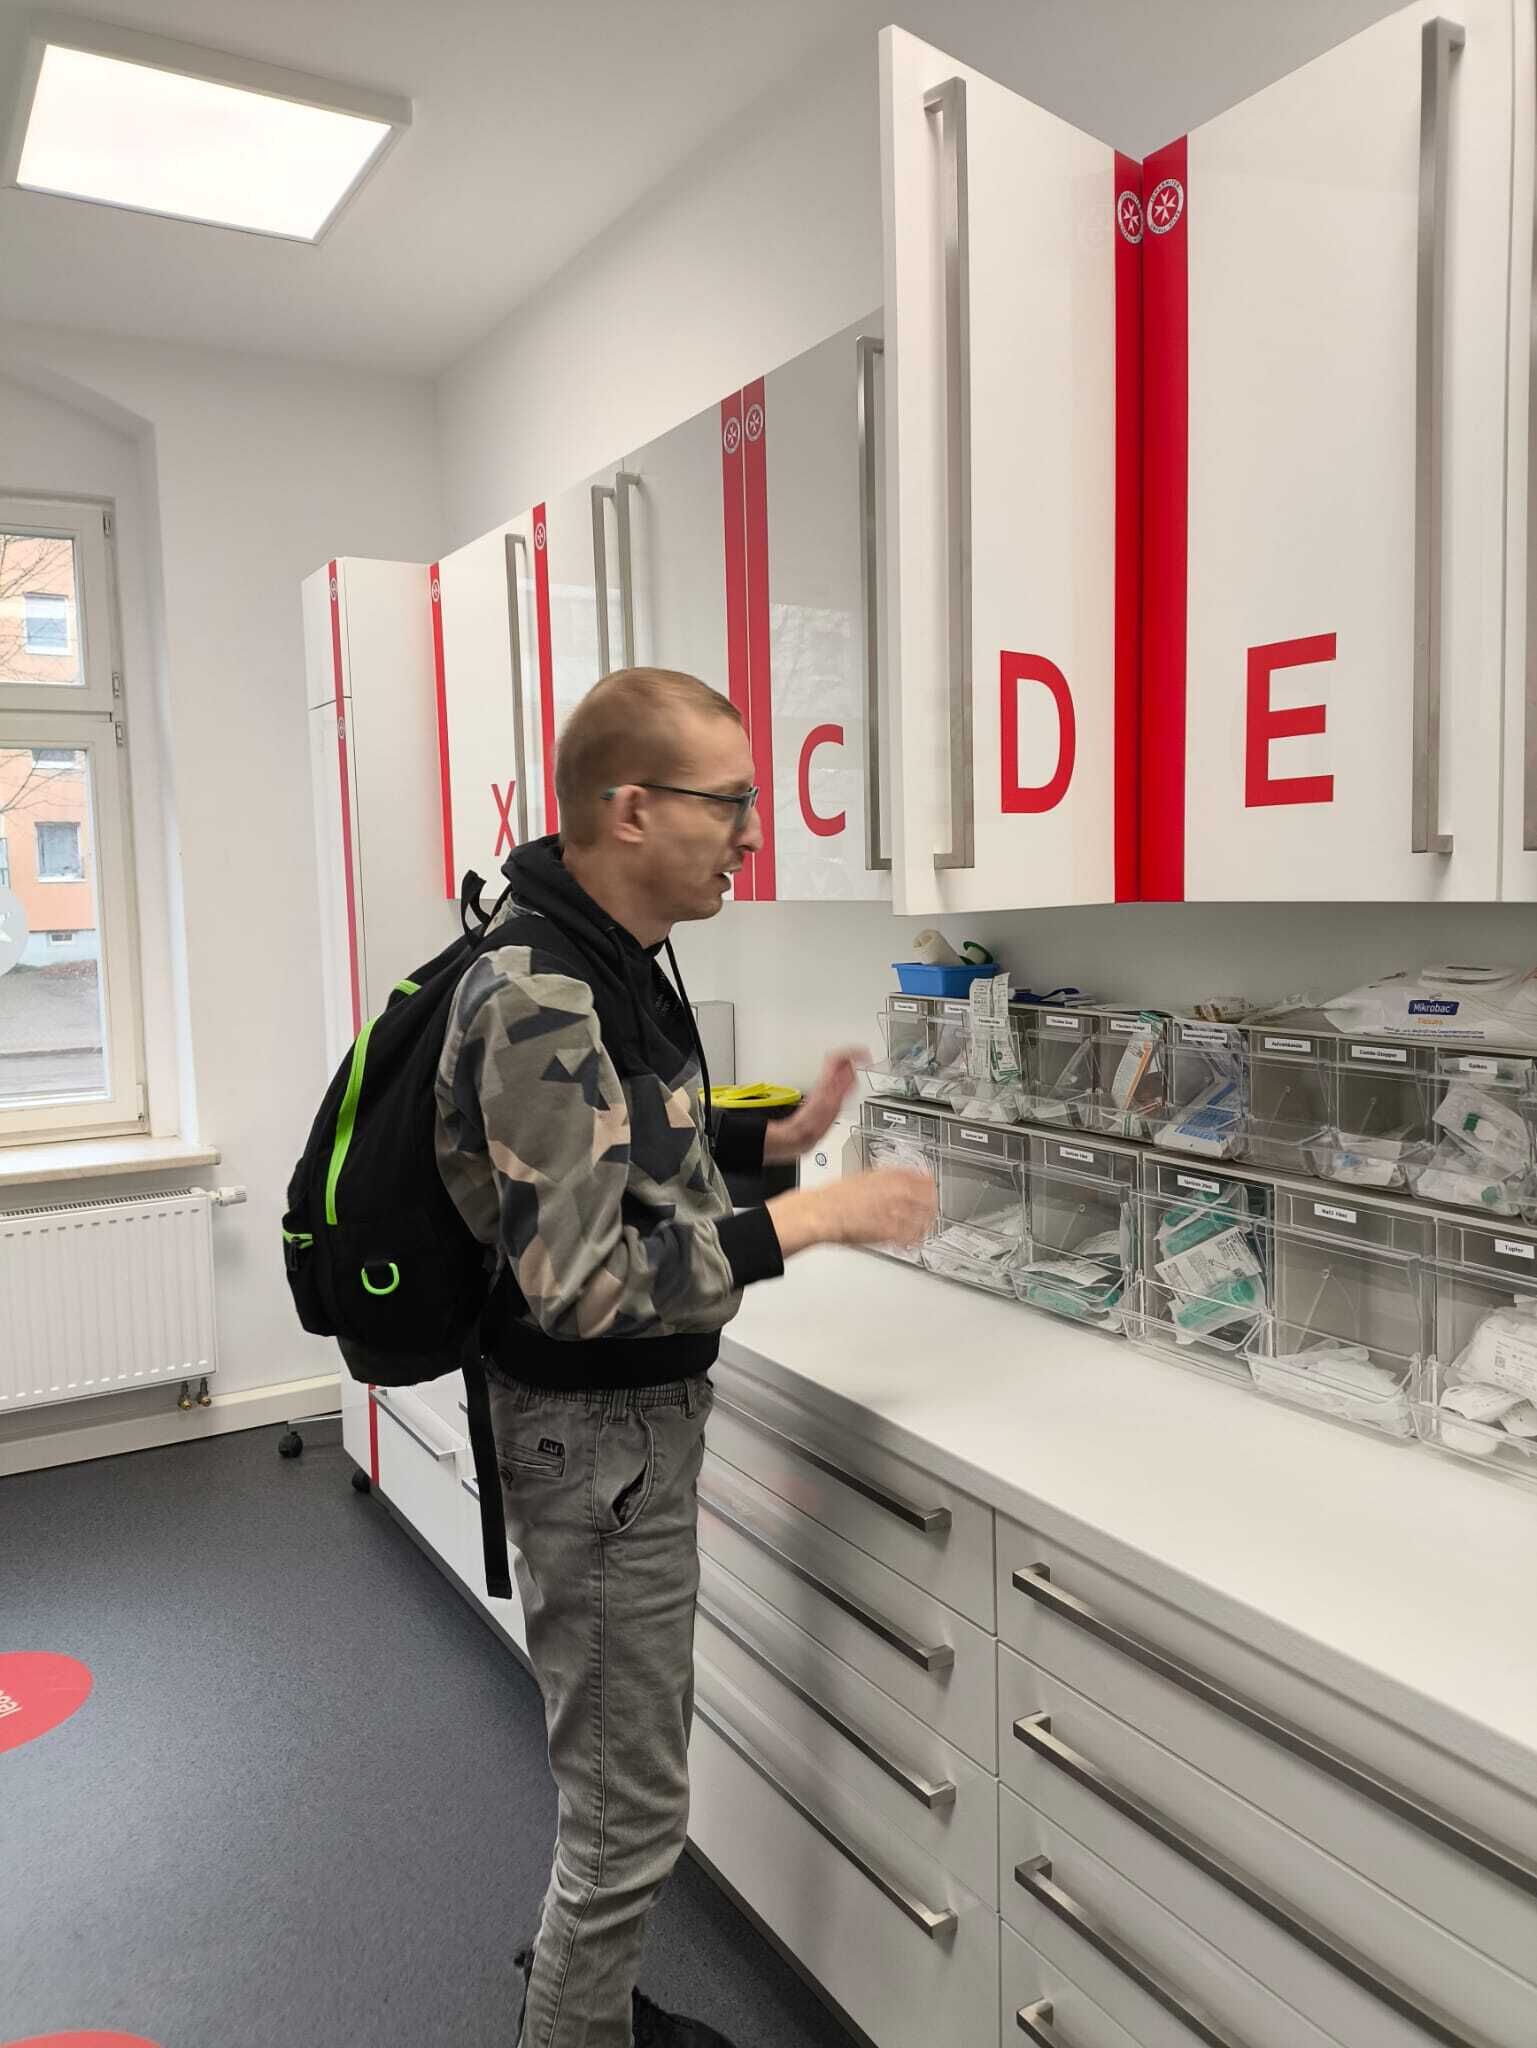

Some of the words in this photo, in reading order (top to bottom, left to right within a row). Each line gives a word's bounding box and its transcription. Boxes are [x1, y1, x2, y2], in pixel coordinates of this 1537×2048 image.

[1000, 650, 1075, 813] D
[1245, 632, 1336, 807] E
[491, 781, 516, 857] X
[798, 724, 846, 836] C
[1413, 1003, 1451, 1013] Mikrobac
